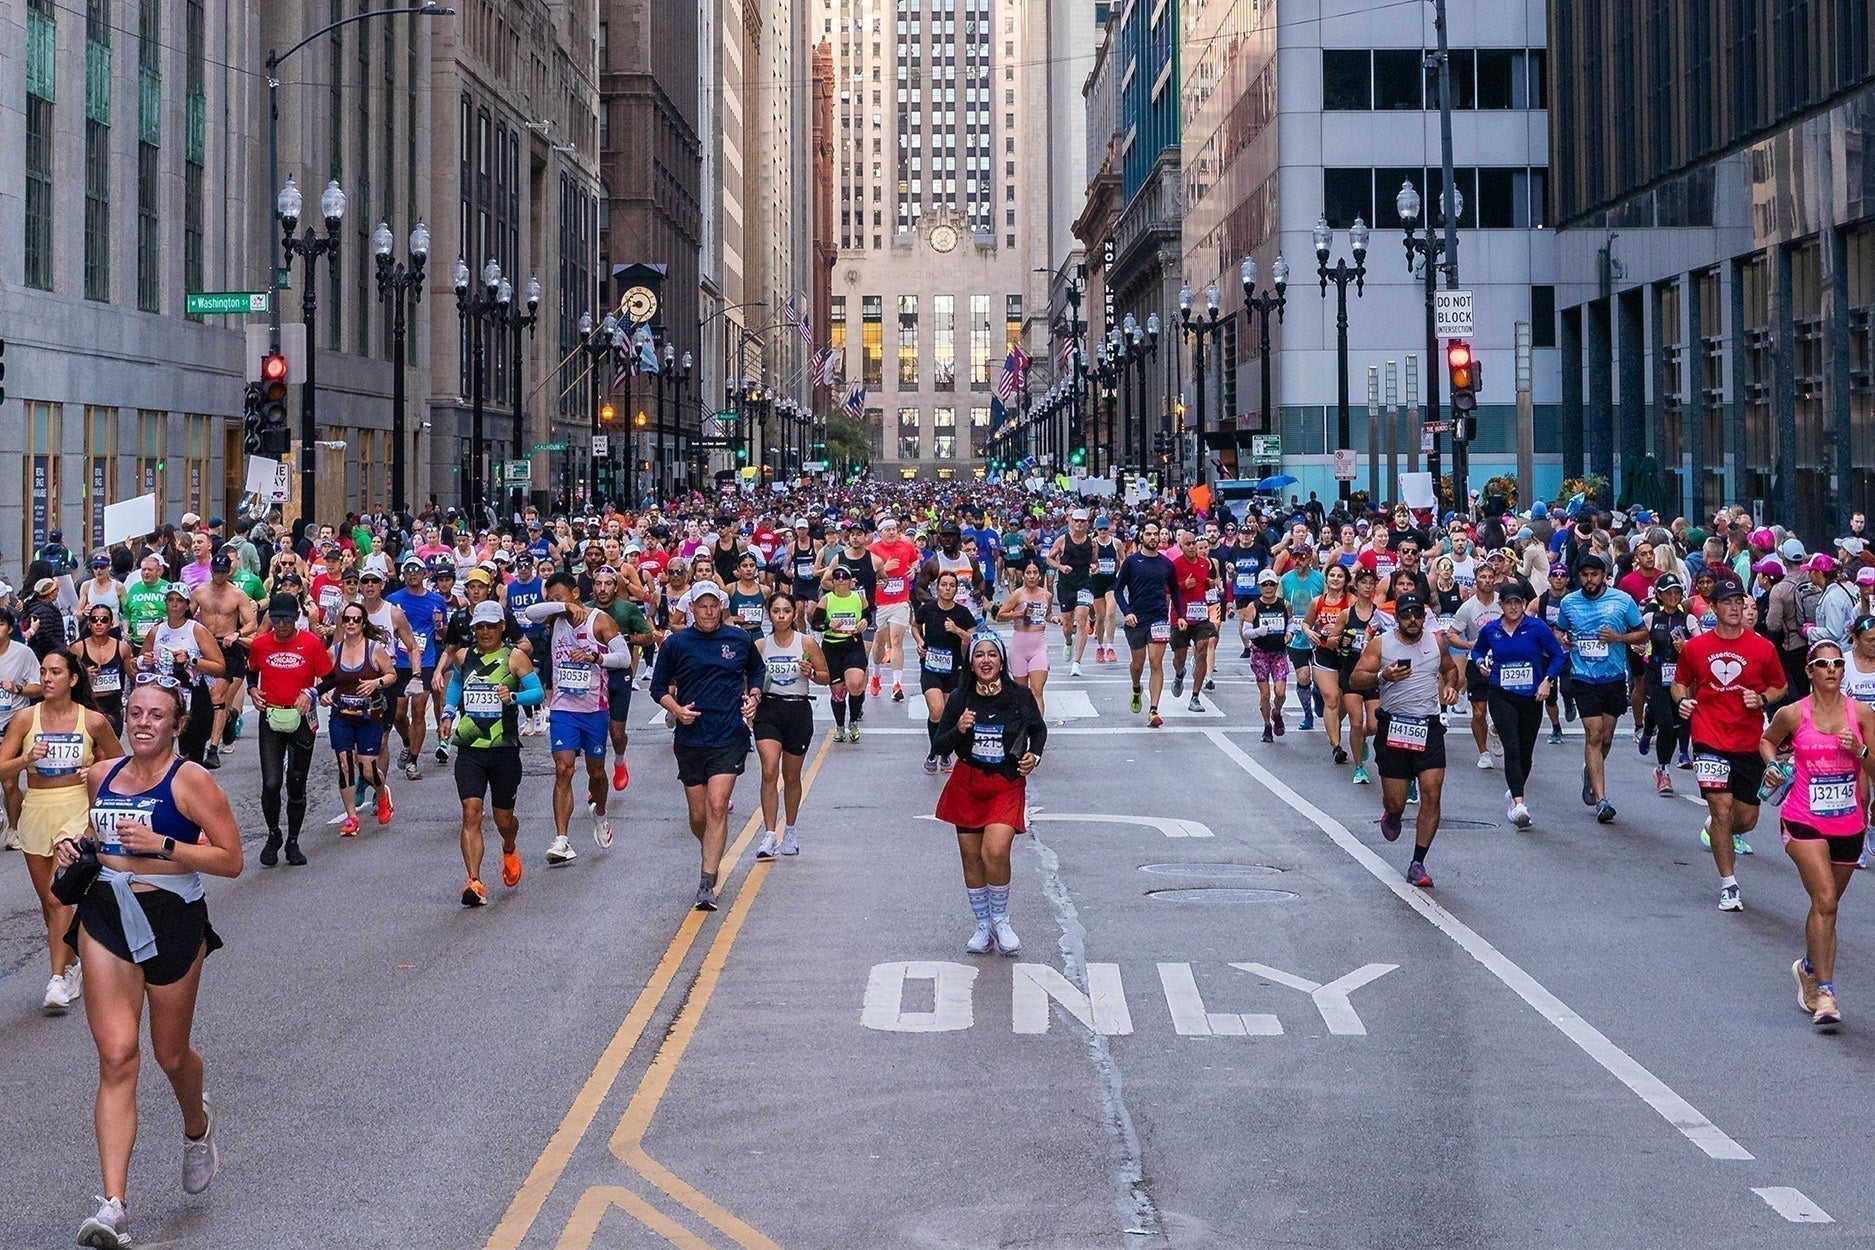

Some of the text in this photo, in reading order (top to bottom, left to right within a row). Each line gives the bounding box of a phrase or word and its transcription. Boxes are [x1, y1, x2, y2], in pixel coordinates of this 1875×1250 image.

[198, 297, 240, 311] Washington
[1437, 296, 1471, 307] DO NOT
[1438, 312, 1472, 323] BLOCK
[132, 592, 166, 602] SONNY
[1707, 651, 1747, 666] Misericordia
[559, 670, 589, 681] J30538
[1502, 669, 1531, 681] J32947
[466, 693, 499, 706] J27335
[1390, 723, 1427, 739] H41560
[47, 745, 80, 759] 4178
[1813, 785, 1854, 803] J32145
[860, 961, 1400, 1035] ONLY
